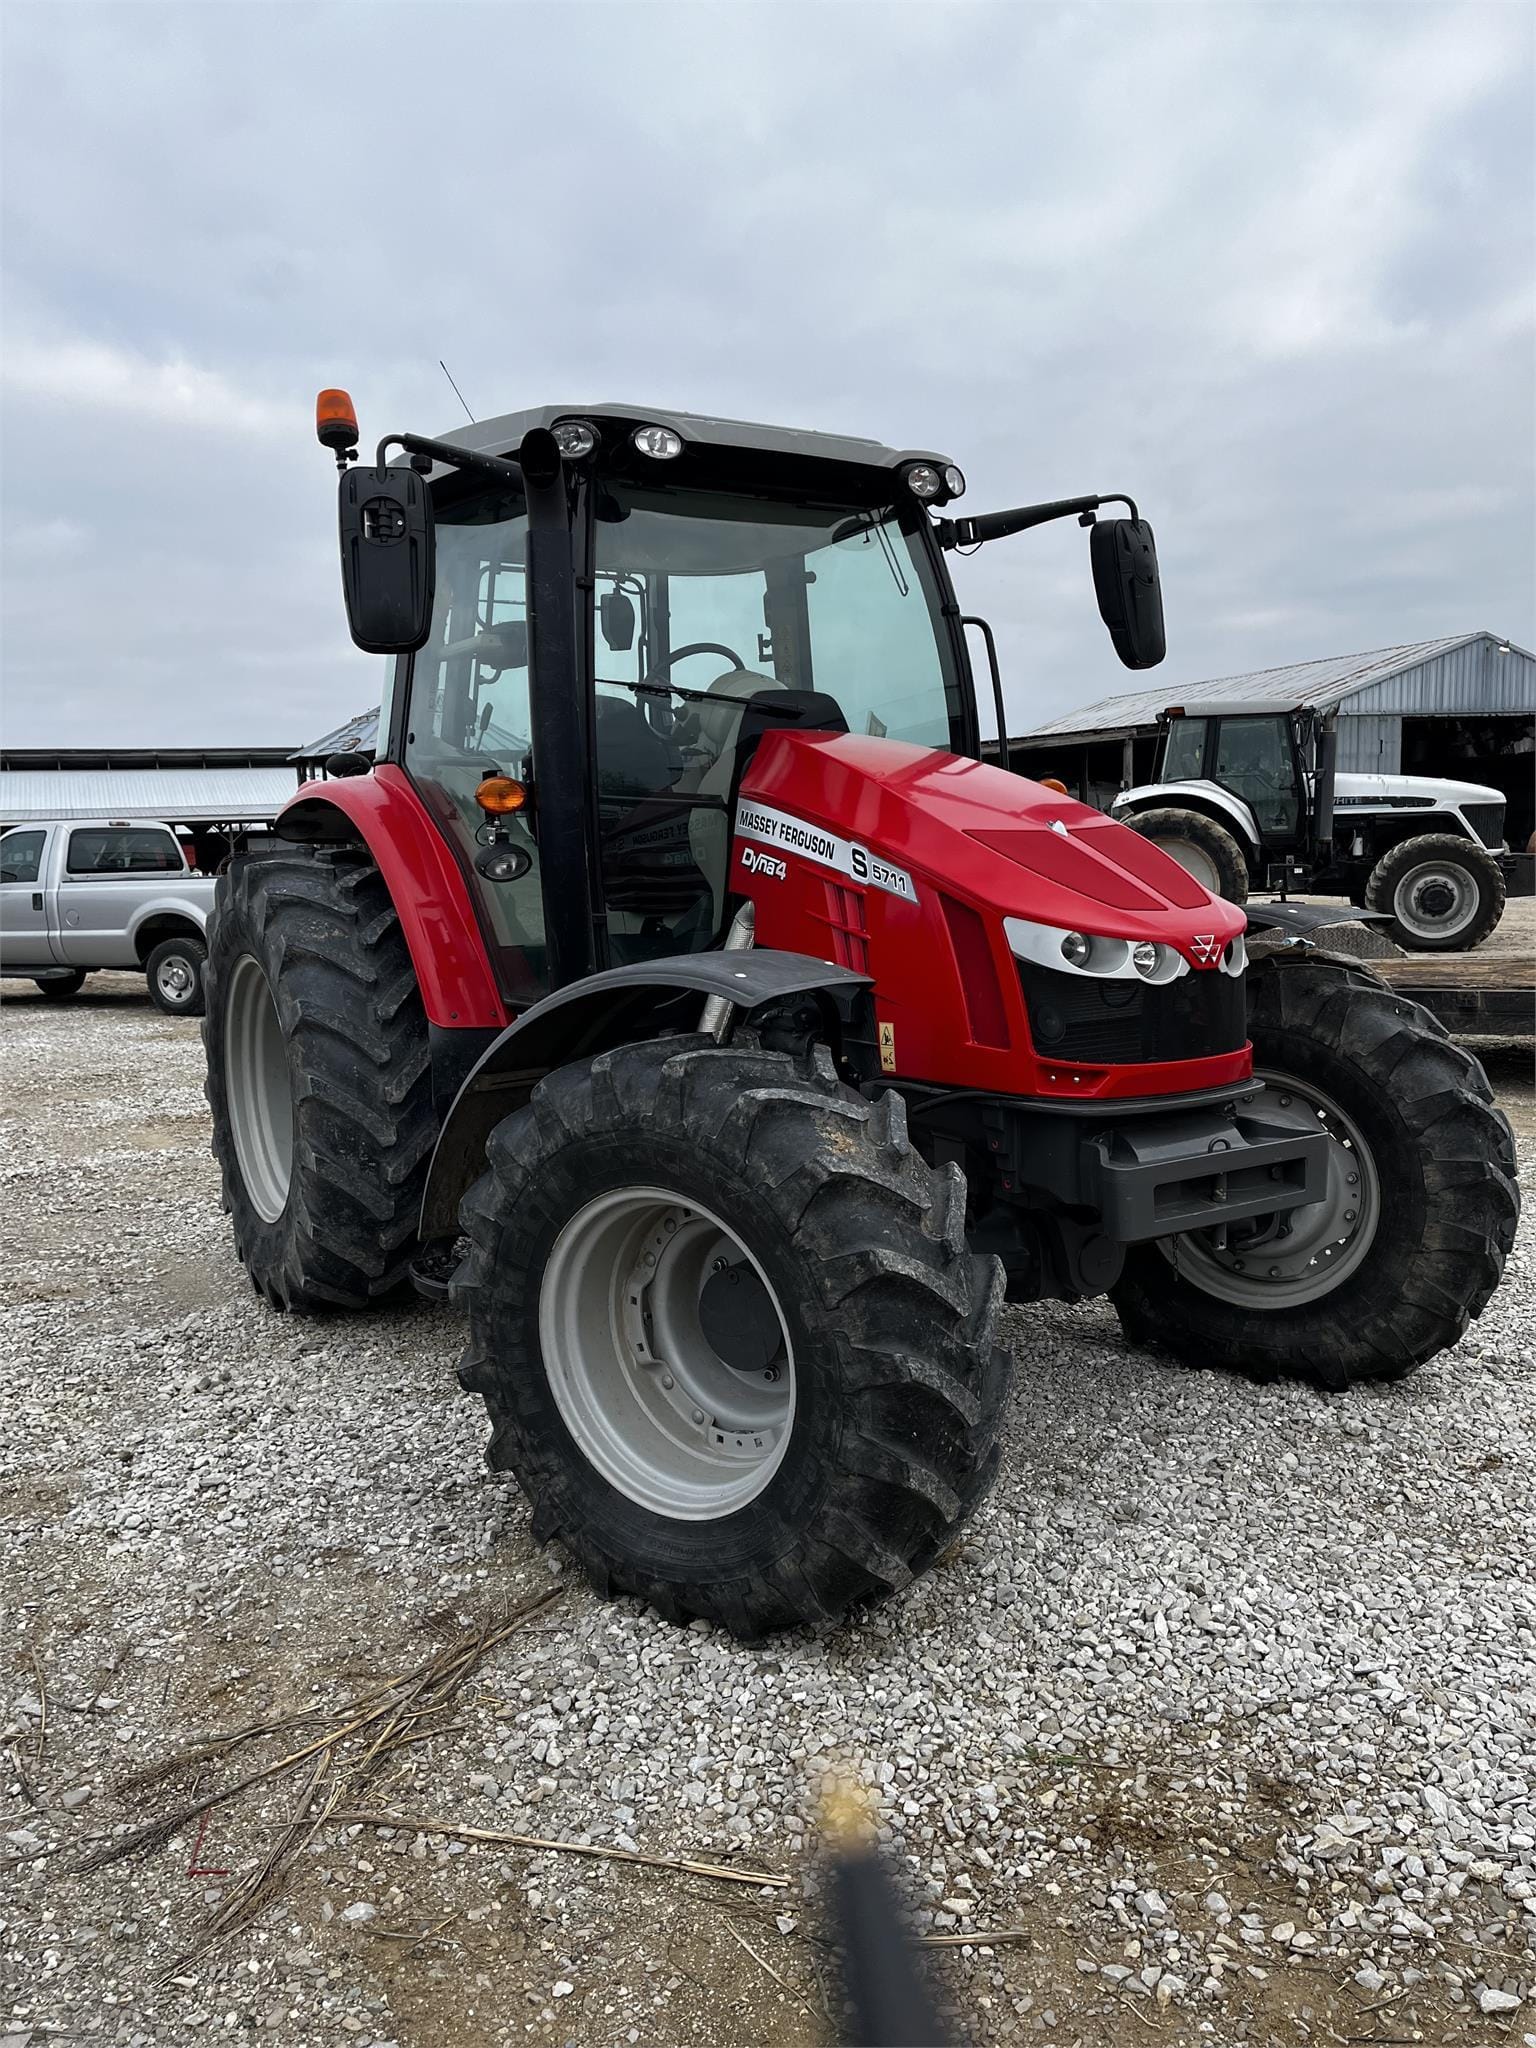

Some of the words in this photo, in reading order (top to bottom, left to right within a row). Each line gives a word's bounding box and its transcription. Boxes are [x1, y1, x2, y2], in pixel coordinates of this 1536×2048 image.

[739, 810, 778, 836] MASSEY
[779, 822, 835, 860] FERGUSON
[851, 847, 868, 880] S
[872, 864, 907, 893] 5711
[741, 847, 787, 881] Dyna4
